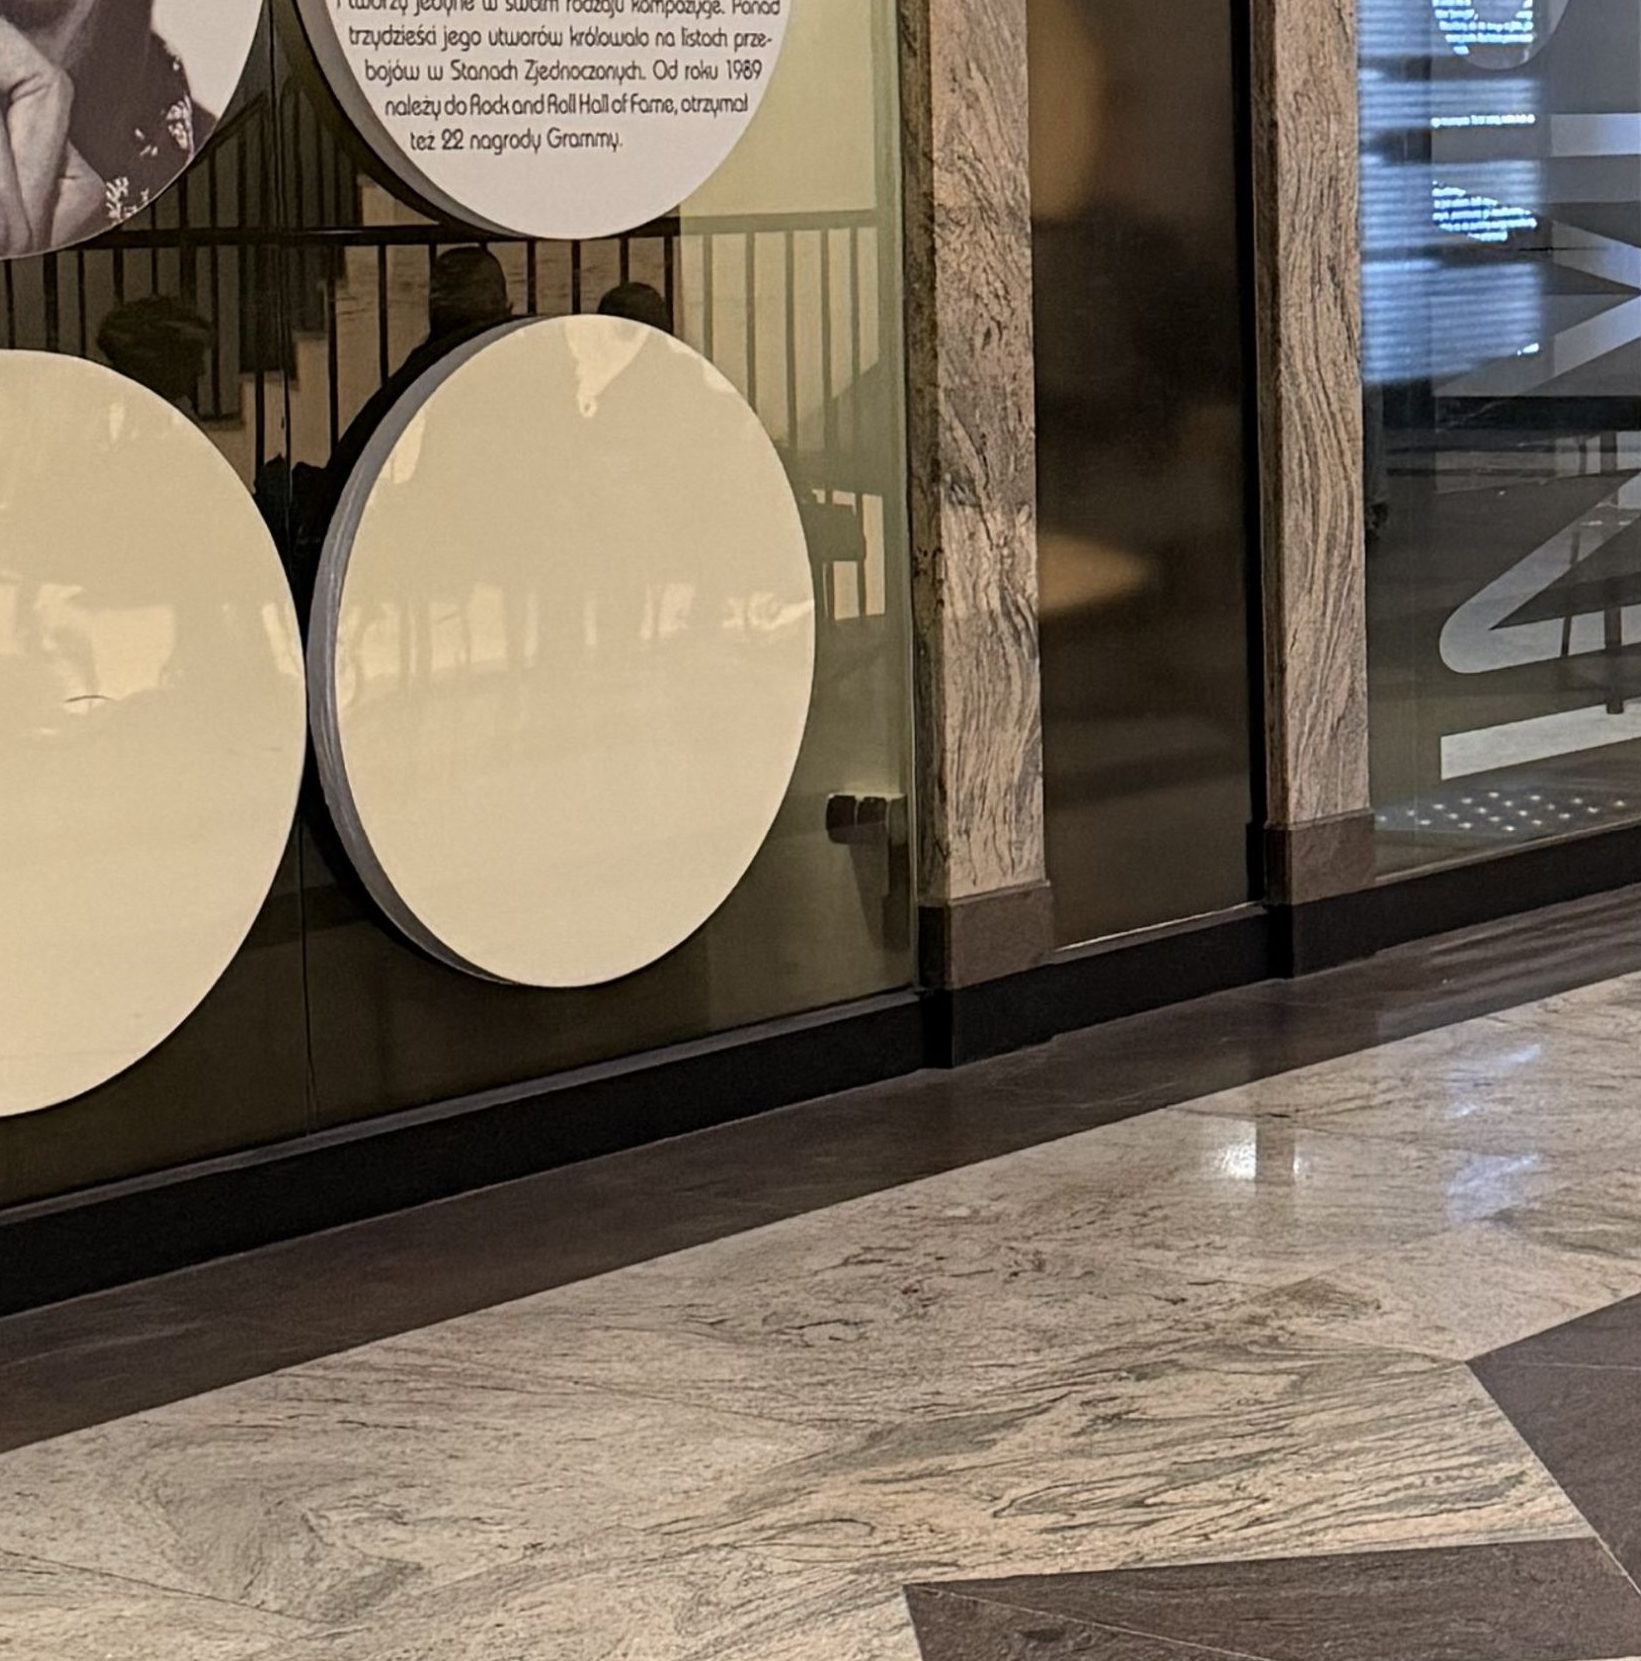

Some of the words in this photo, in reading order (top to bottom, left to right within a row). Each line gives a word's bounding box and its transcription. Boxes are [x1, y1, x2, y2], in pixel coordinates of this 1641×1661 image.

[384, 92, 441, 122] należy
[443, 92, 468, 116] do
[469, 92, 510, 116] Rock
[510, 92, 545, 115] and
[546, 92, 577, 115] Roll
[578, 91, 609, 115] Hall
[610, 91, 629, 114] of
[628, 91, 678, 116] Fame,
